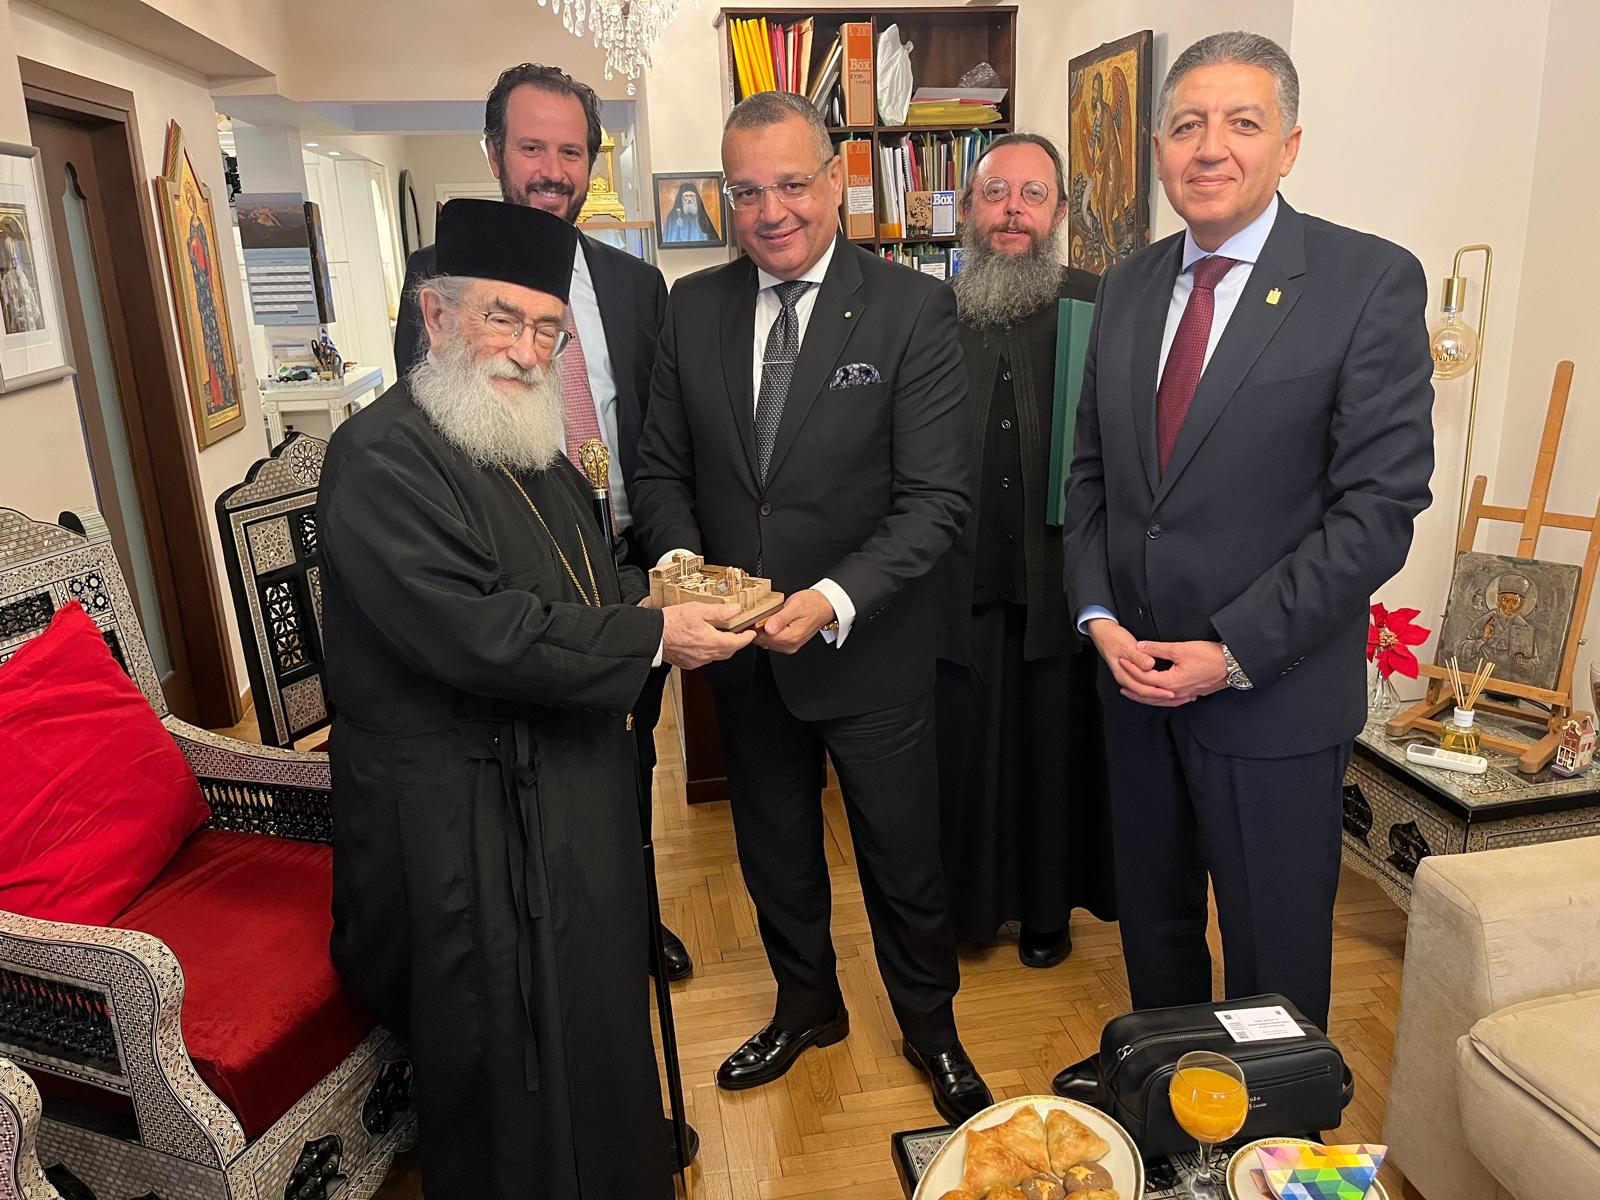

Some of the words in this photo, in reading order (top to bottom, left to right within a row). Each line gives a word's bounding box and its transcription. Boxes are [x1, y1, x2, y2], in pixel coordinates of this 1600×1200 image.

[849, 59, 871, 70] Box
[849, 175, 870, 186] Box
[932, 194, 953, 205] Box
